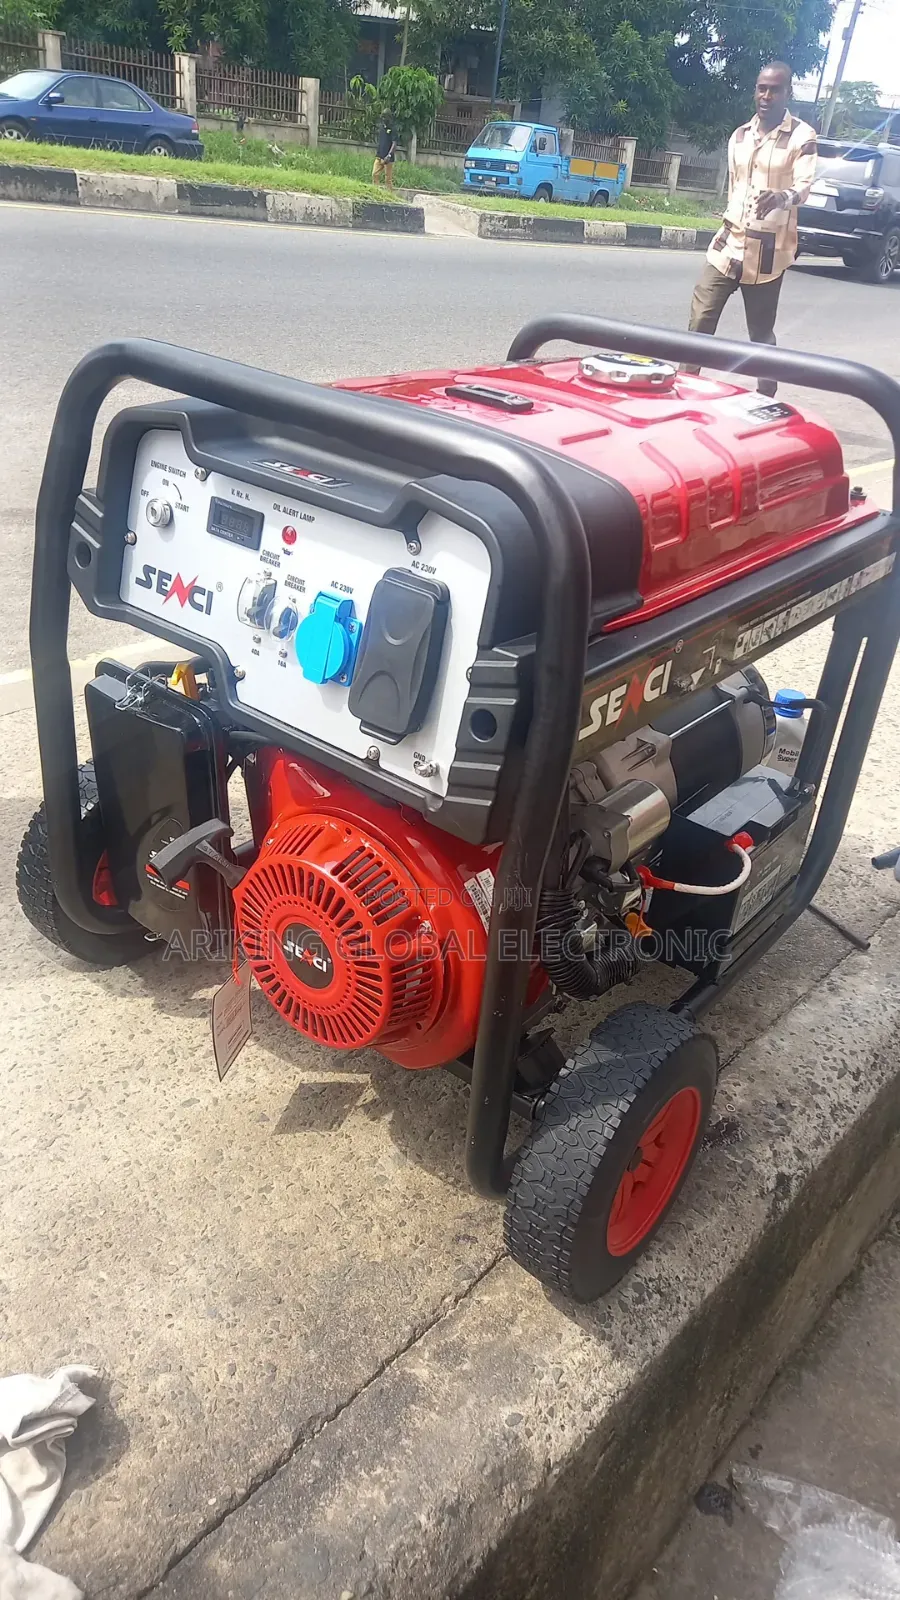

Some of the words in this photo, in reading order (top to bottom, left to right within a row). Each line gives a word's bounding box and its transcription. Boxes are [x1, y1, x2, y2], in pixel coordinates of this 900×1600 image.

[151, 460, 168, 471] ENGINE
[168, 466, 187, 478] SWITCH
[162, 478, 169, 487] ON
[141, 489, 150, 497] OFF
[175, 502, 190, 513] START
[272, 502, 281, 512] OIL
[282, 505, 299, 518] ALERT
[299, 511, 316, 523] LAMP
[262, 549, 280, 561] CIRCUIT
[260, 555, 281, 568] BREAKER
[411, 560, 420, 570] AC
[420, 563, 437, 575] 230V
[287, 574, 305, 586] CIRCUIT
[135, 564, 214, 616] SENCI
[284, 580, 306, 593] BREAKER
[330, 580, 339, 589] AC
[339, 583, 354, 595] 230V
[251, 648, 260, 656] 40A
[413, 751, 426, 762] GND
[777, 754, 797, 762] Super
[779, 748, 799, 757] Mobil
